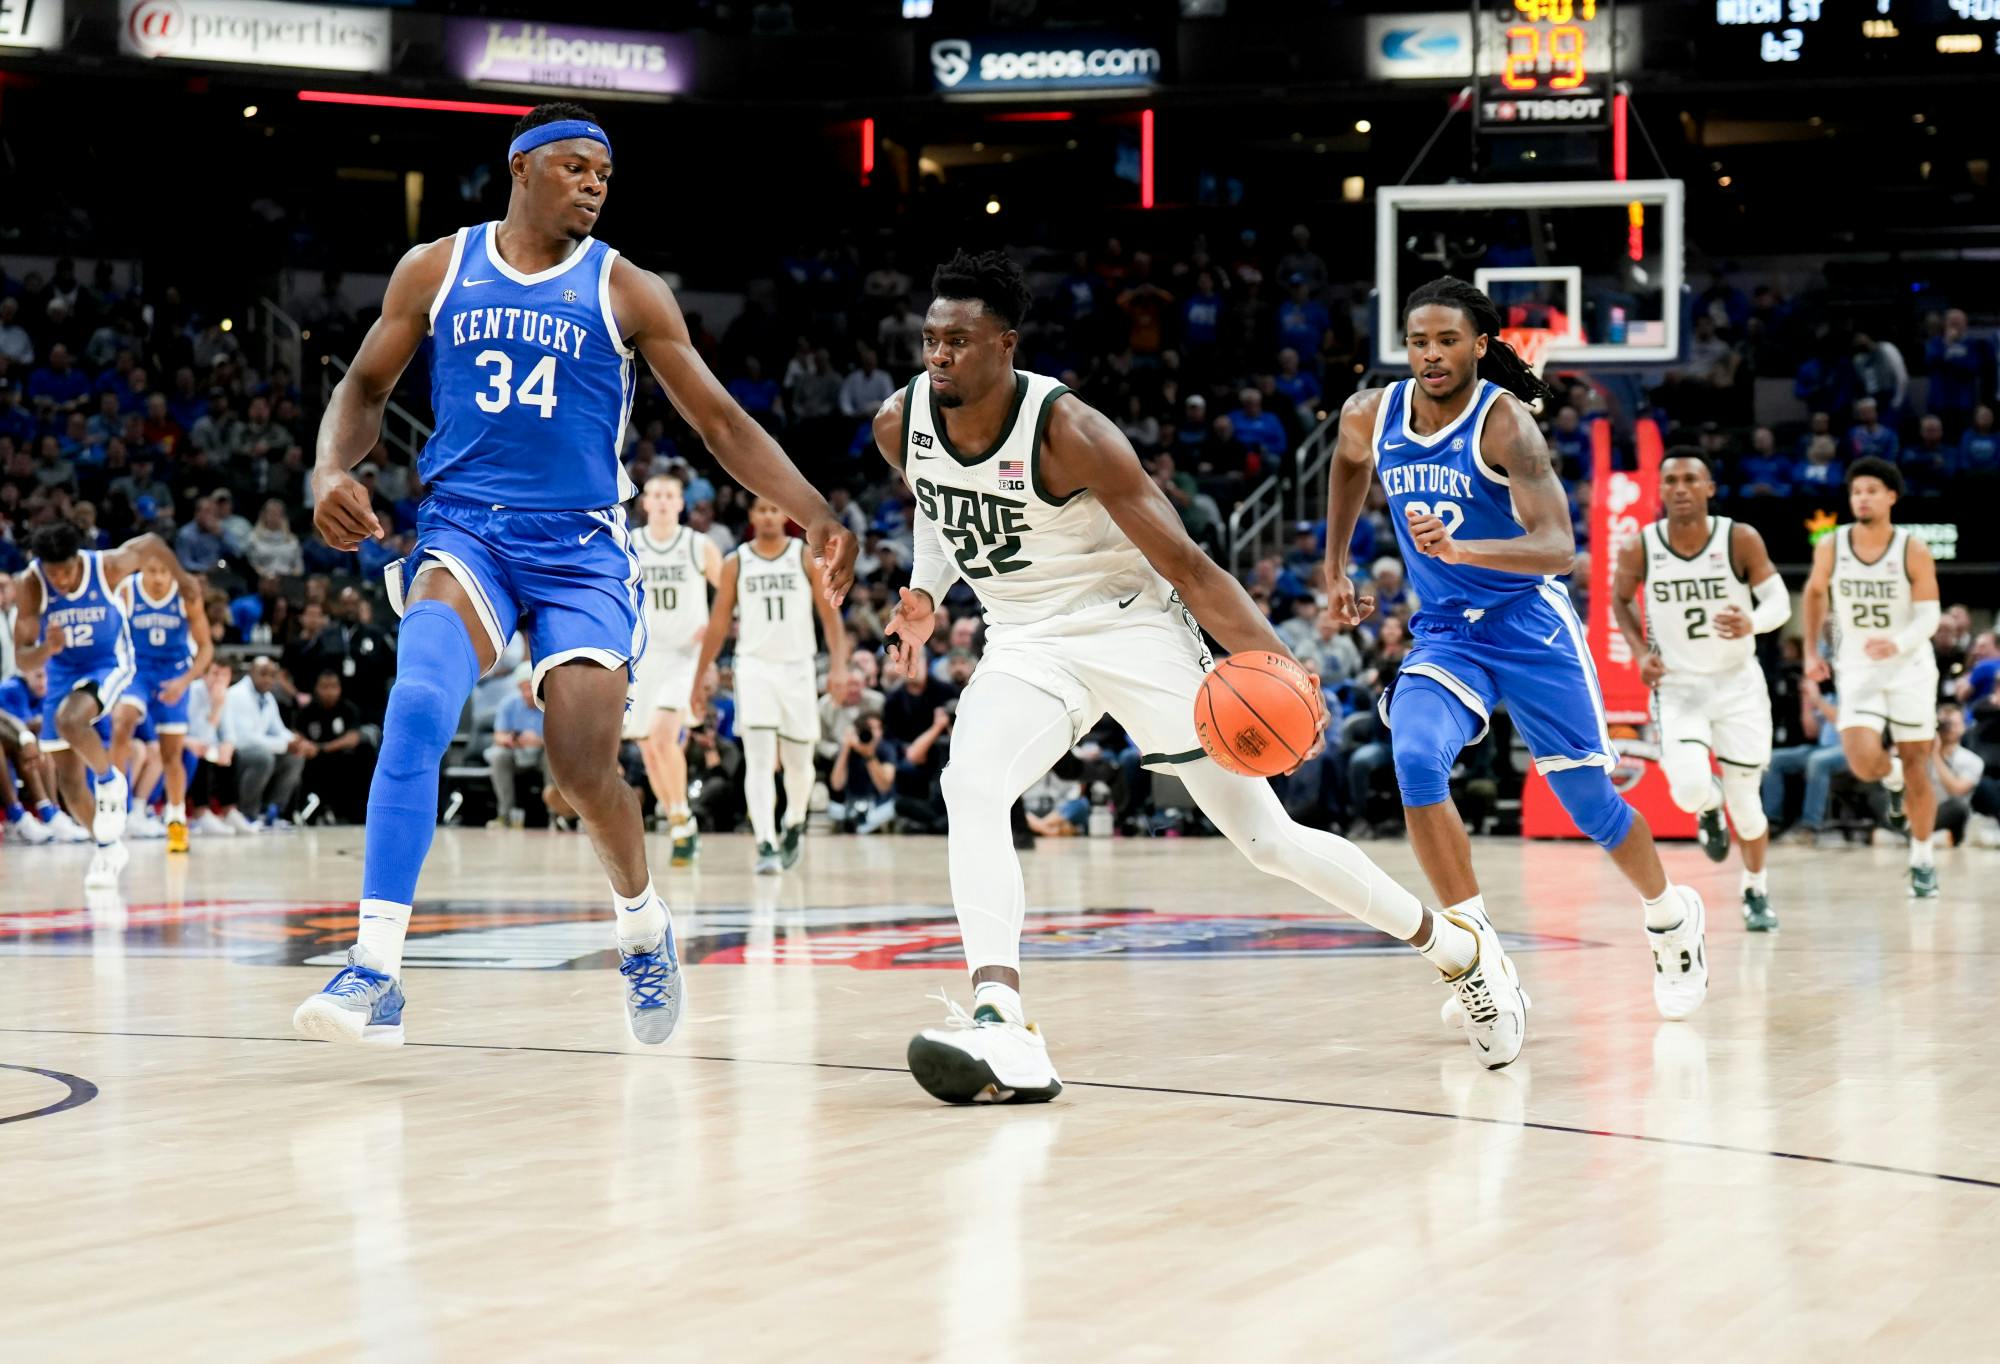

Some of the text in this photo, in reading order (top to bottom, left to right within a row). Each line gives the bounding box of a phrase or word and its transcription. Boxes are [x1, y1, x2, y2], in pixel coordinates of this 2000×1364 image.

[546, 38, 666, 72] DONUTS
[1503, 26, 1584, 90] 29
[1760, 28, 1804, 62] 62
[980, 48, 1161, 80] socios.com
[1518, 98, 1604, 120] TISSOT
[453, 307, 587, 360] KENTUCKY
[475, 349, 558, 418] 34
[1382, 463, 1474, 498] KENTUCKY
[916, 477, 1033, 545] STATE
[942, 528, 1033, 579] 22
[652, 587, 676, 610] 10
[746, 574, 798, 592] STATE
[1652, 577, 1729, 602] STATE
[1840, 579, 1898, 599] STATE
[763, 597, 785, 621] 11
[1684, 607, 1710, 640] 2
[1852, 604, 1890, 628] 25
[64, 624, 94, 648] 12
[149, 627, 166, 646] 0
